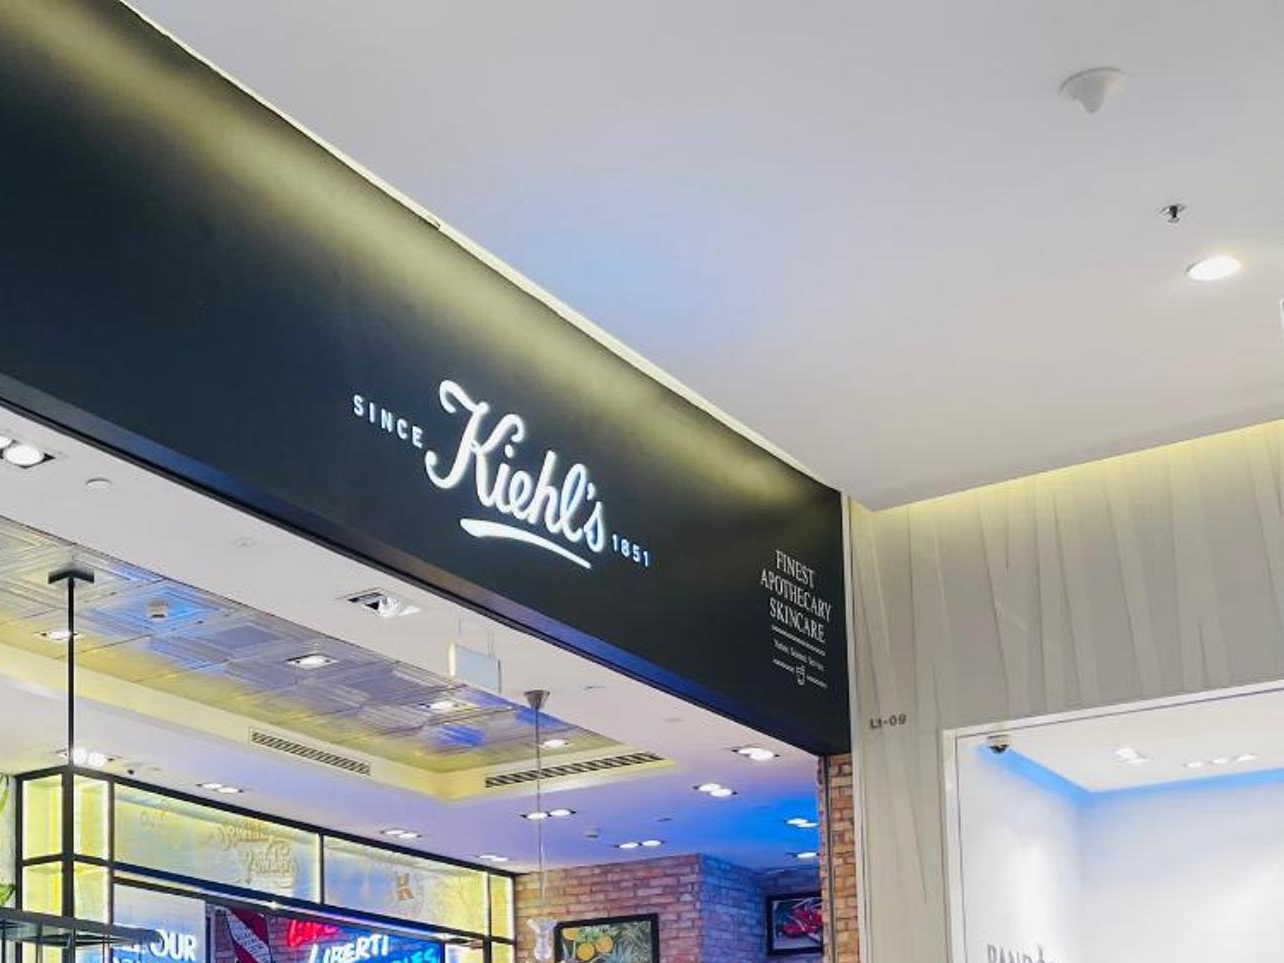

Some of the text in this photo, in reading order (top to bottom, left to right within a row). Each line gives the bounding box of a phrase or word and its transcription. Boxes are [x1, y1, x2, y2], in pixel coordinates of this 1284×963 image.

[352, 379, 651, 568] SINCE Kiehl's 1851
[760, 567, 831, 622] APOTHECARY
[775, 549, 814, 589] FINEST
[769, 596, 827, 644] SKINCARE
